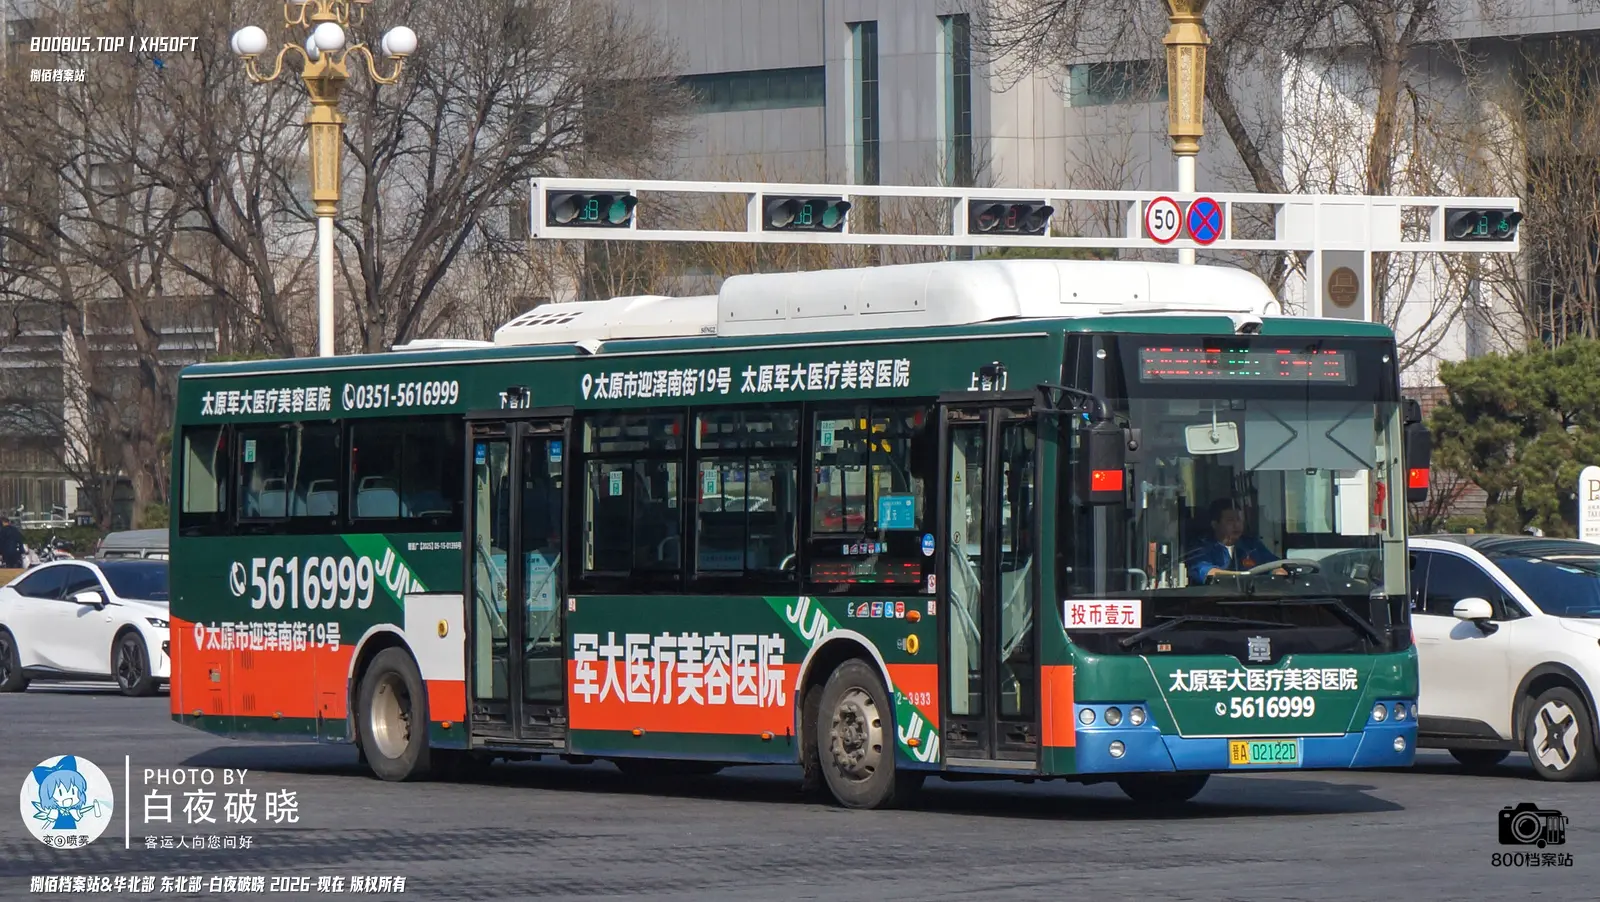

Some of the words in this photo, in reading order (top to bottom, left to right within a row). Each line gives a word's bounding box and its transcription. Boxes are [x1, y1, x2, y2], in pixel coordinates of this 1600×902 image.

[1154, 209, 1175, 230] 50
[593, 366, 732, 400] 太原市迎泽南街19号
[740, 357, 910, 395] 太原军大医疗美容医院
[200, 385, 332, 417] 太原军大医疗美容医院
[356, 380, 459, 410] 0351-5616999
[250, 555, 375, 610] 5616999
[1070, 603, 1138, 627] 投币壹元
[206, 621, 341, 652] 太原市迎泽南街19号
[573, 631, 786, 708] 军大医疗美容医院
[1168, 667, 1359, 692] 太原军大医疗美容医院
[1230, 696, 1315, 719] 5616999
